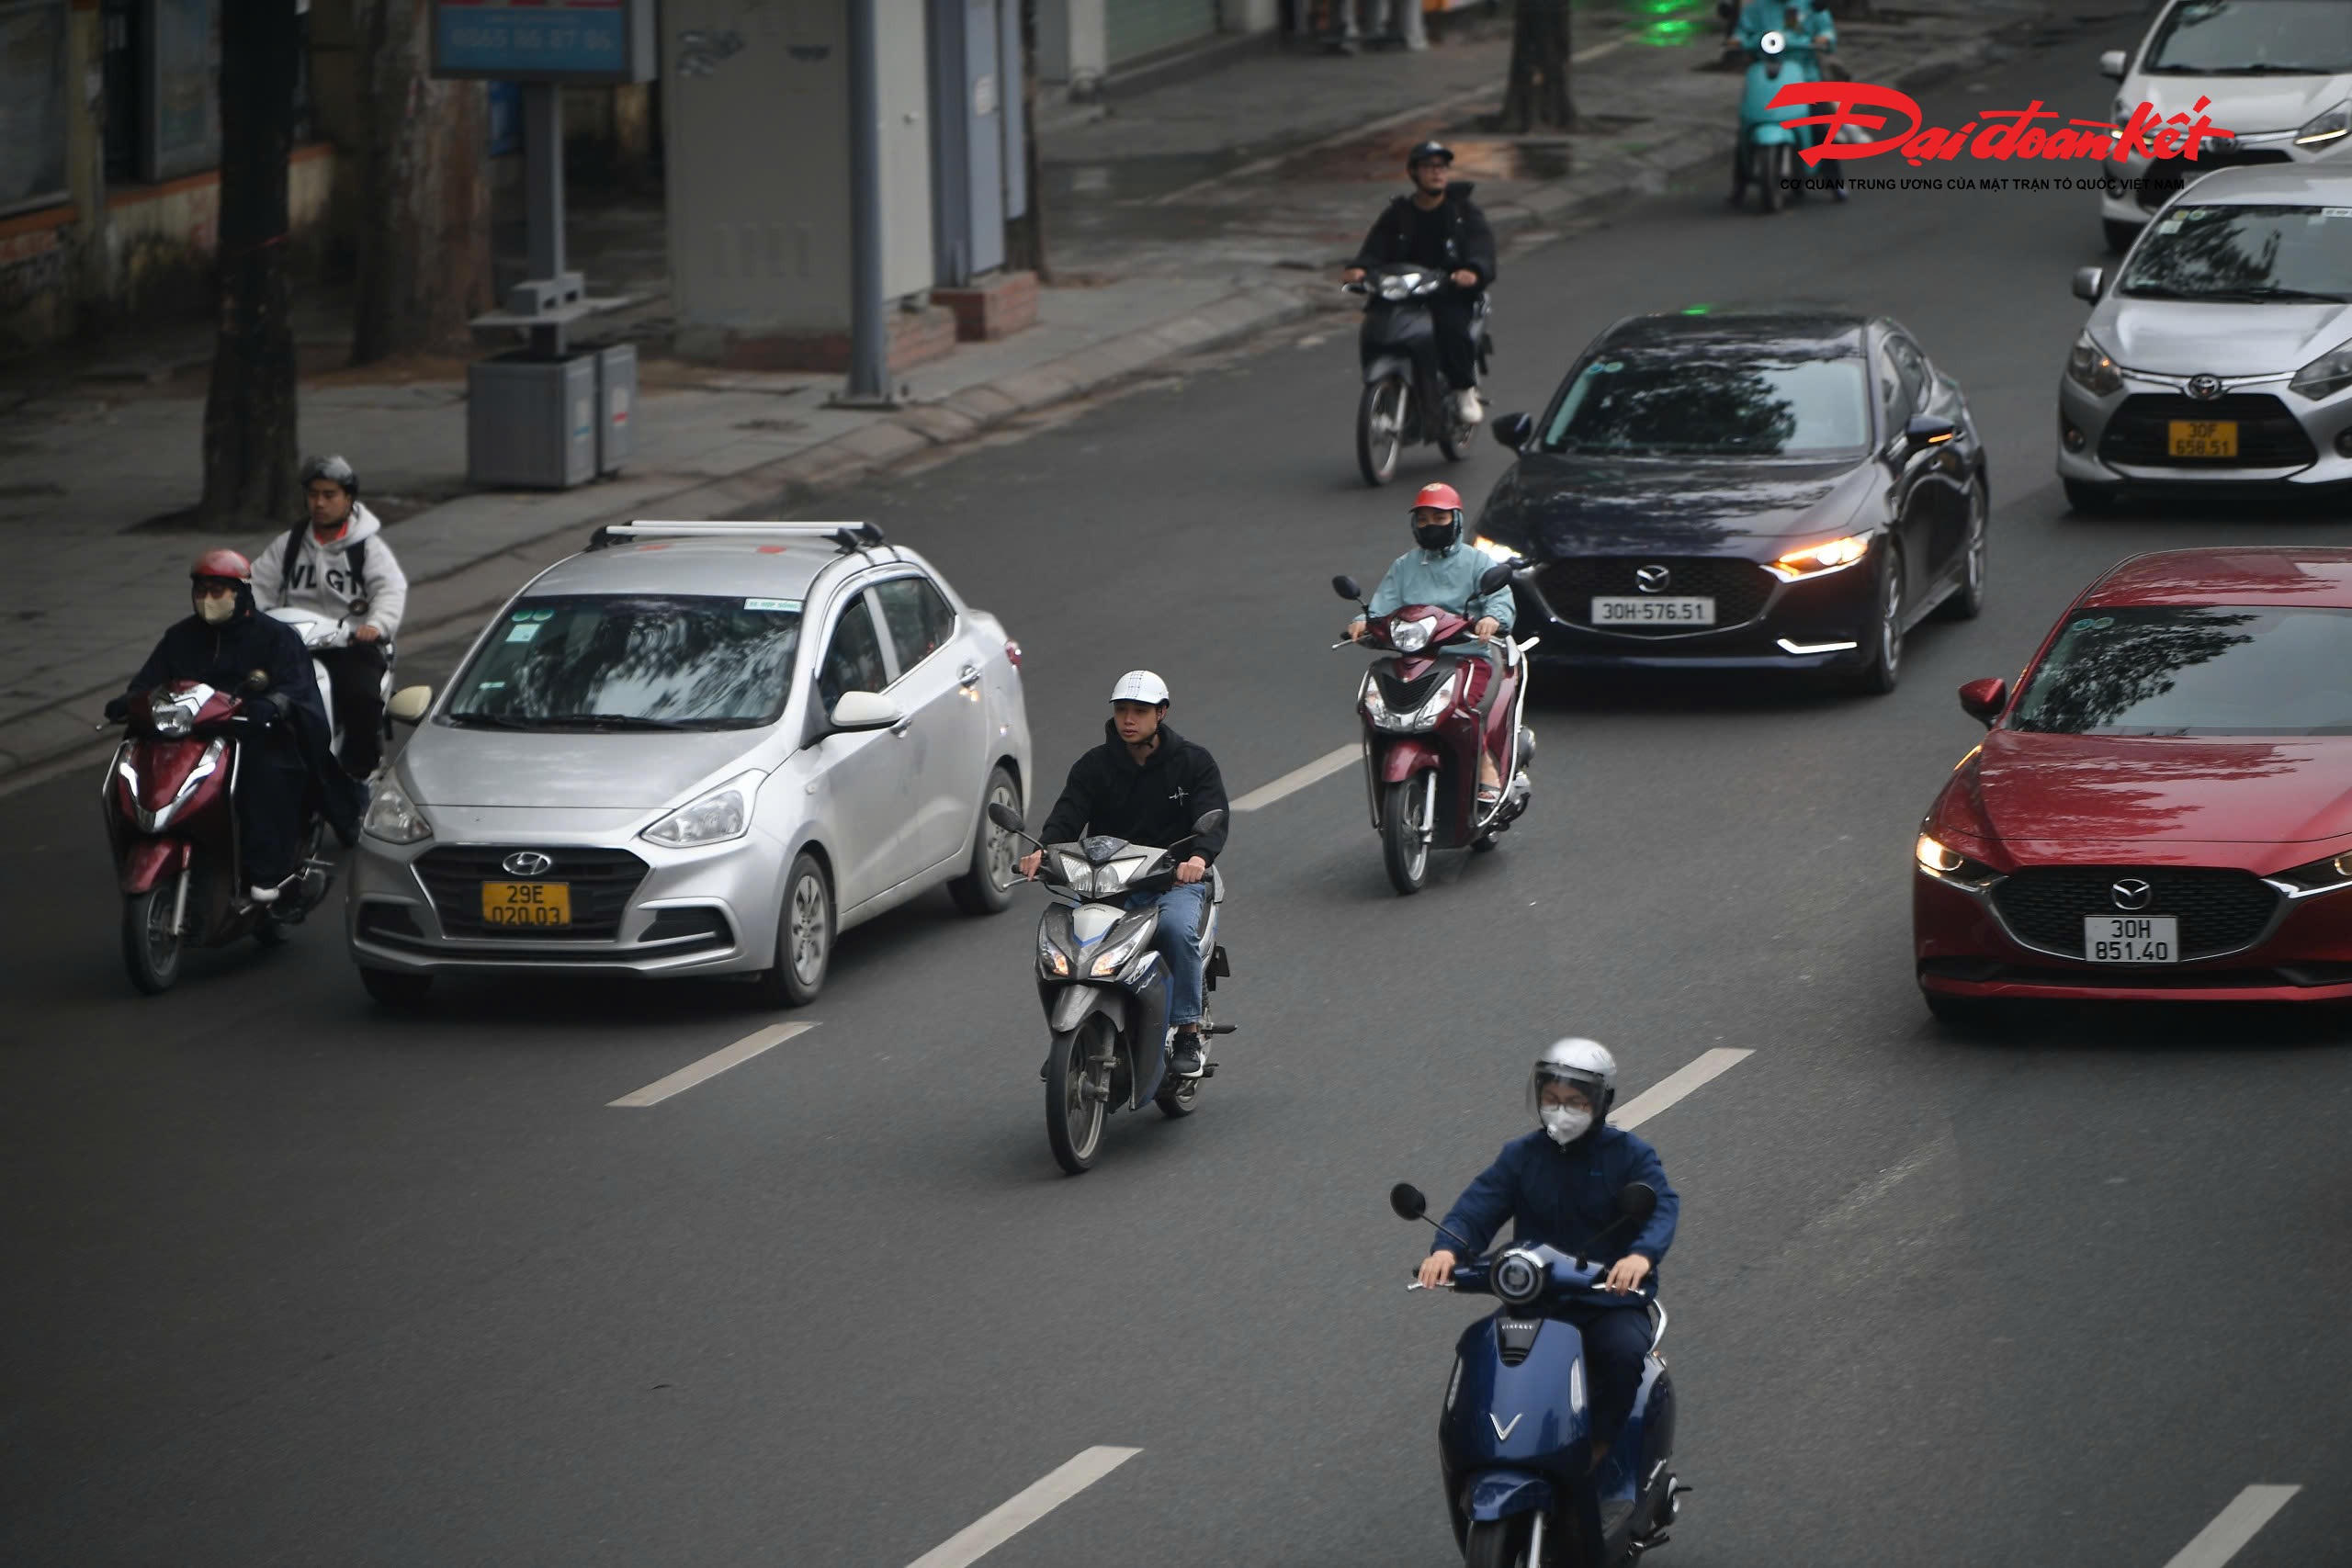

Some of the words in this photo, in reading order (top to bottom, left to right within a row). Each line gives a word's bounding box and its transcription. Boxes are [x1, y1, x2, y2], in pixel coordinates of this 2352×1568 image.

[1602, 603, 1704, 620] 30H-576.51
[506, 885, 544, 904] 29E
[2111, 919, 2152, 938] 30H
[2096, 942, 2168, 960] 851.40
